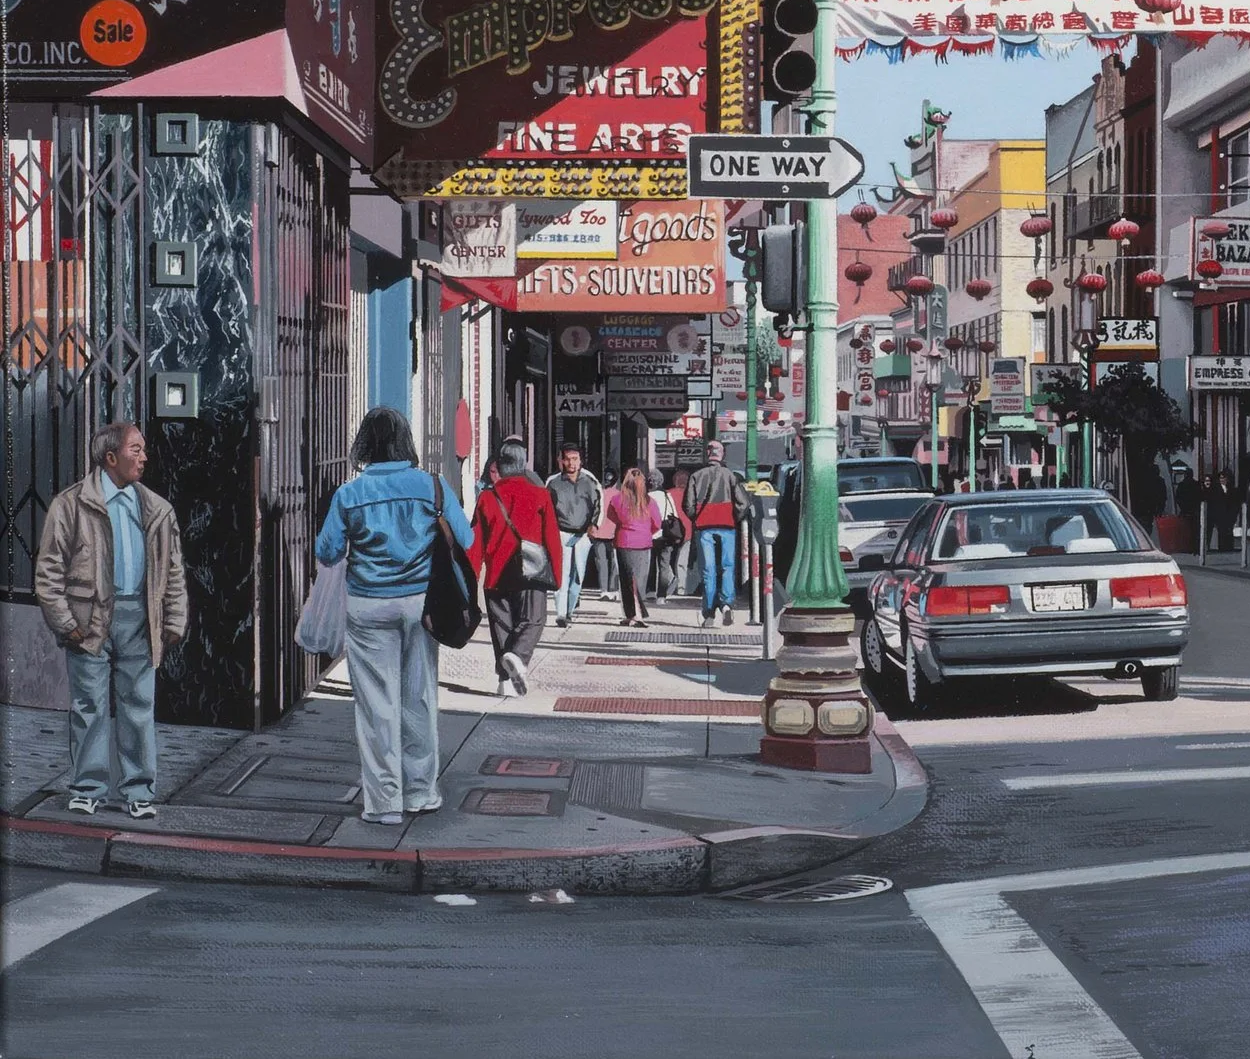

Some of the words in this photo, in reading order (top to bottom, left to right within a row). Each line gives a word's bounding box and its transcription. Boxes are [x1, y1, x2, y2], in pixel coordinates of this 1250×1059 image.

[93, 19, 135, 44] Sale
[532, 65, 707, 99] JEWELRY
[496, 120, 578, 153] FINE
[588, 121, 693, 155] ARTS
[709, 153, 761, 178] ONE
[771, 155, 827, 178] WAY
[452, 212, 503, 231] GIFTS
[450, 244, 507, 259] CENTER
[517, 265, 579, 296] IFTS
[607, 338, 658, 349] CENTER
[1194, 367, 1244, 380] EMPRESS
